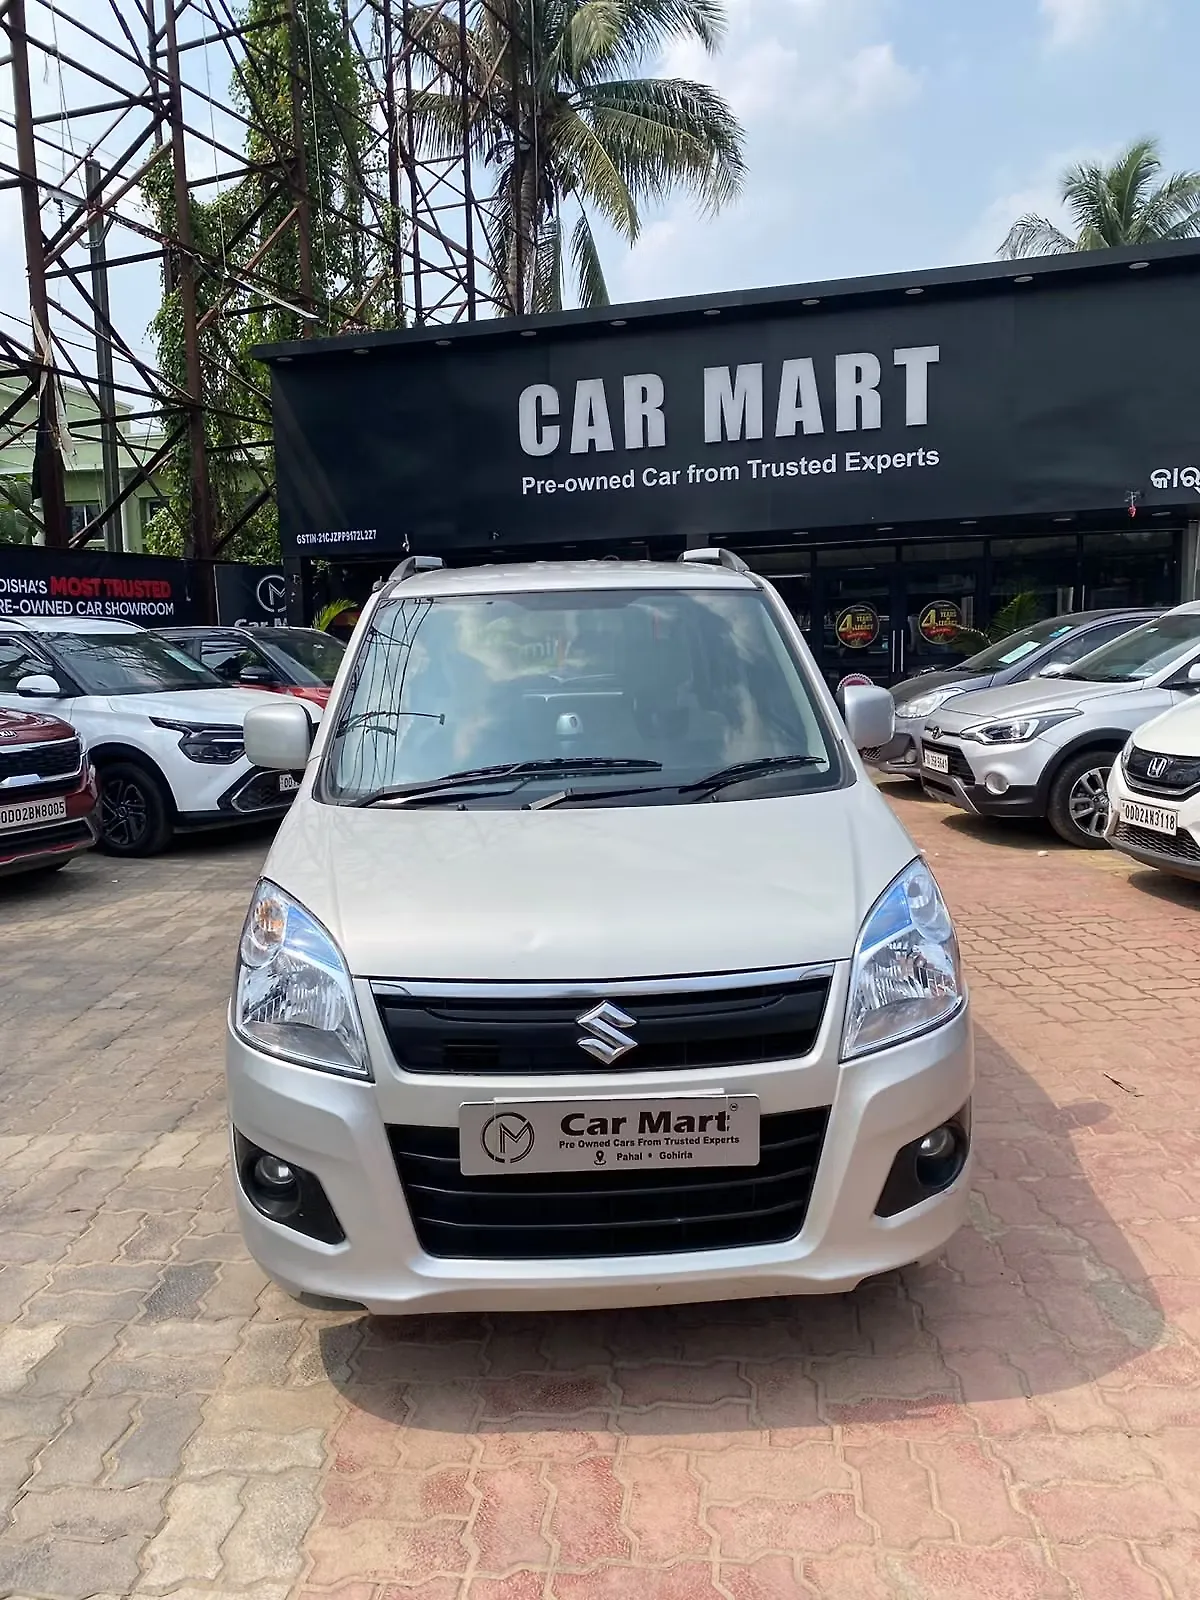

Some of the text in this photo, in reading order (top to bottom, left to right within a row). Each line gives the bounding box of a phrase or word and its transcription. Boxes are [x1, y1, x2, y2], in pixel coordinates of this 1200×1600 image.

[518, 345, 940, 457] CAR MART
[521, 447, 940, 496] Pre-owned Car from Trusted Experts
[50, 576, 101, 596] MOST
[103, 578, 171, 598] TRUSTED
[76, 601, 103, 615] CAR
[105, 602, 174, 616] SHOWROOM
[560, 1109, 730, 1136] Car Mart
[559, 1135, 740, 1149] Pre Owned Cars From Trusted Experts
[616, 1152, 643, 1161] Pahal
